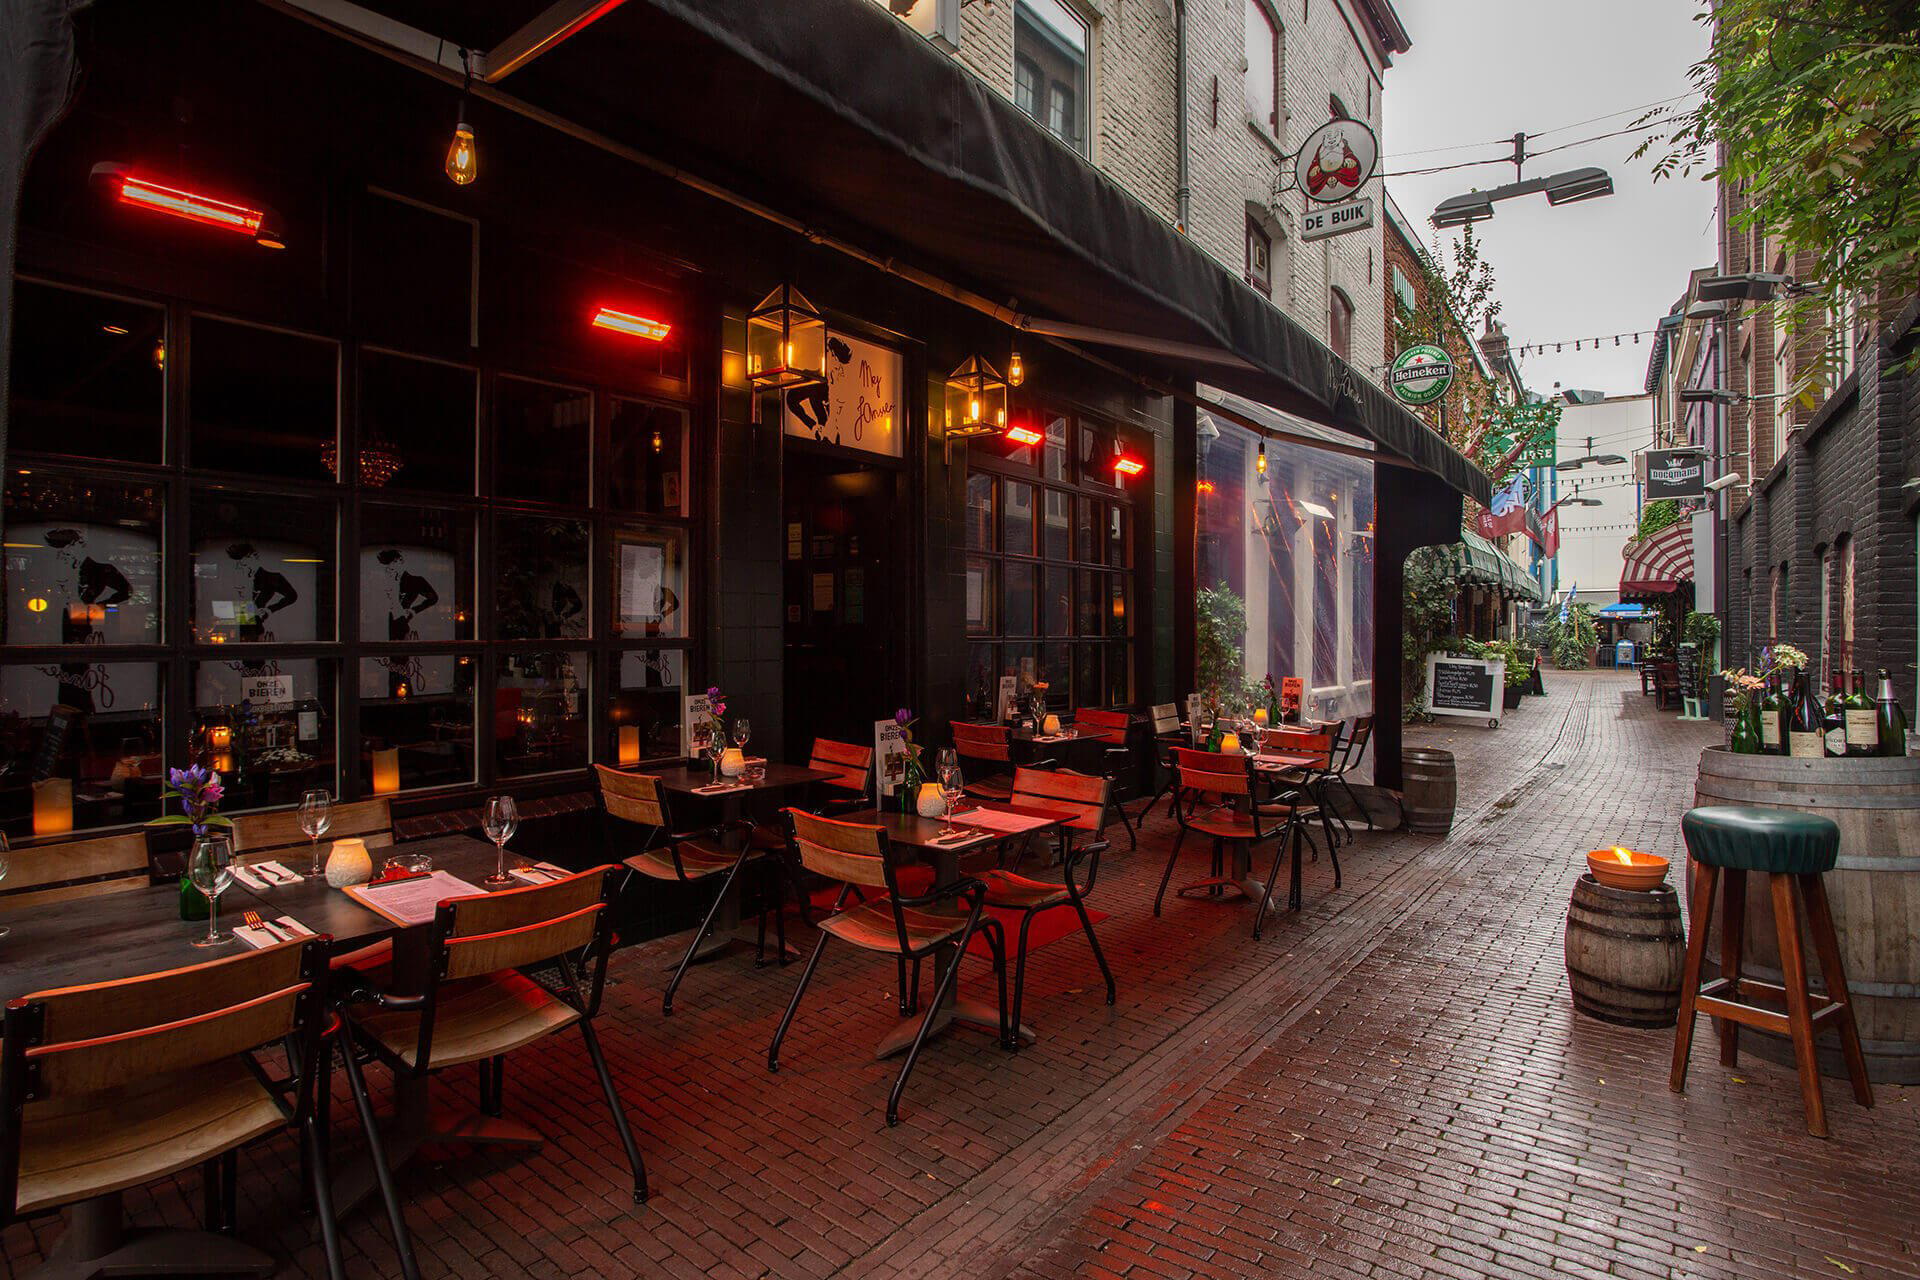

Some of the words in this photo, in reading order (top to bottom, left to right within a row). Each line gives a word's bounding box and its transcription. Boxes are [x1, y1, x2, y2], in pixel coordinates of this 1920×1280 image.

[1305, 215, 1324, 231] DE
[1331, 204, 1364, 225] BUIK
[1395, 366, 1447, 382] Heineken
[256, 680, 280, 689] ONZE
[248, 687, 286, 698] BIEREN
